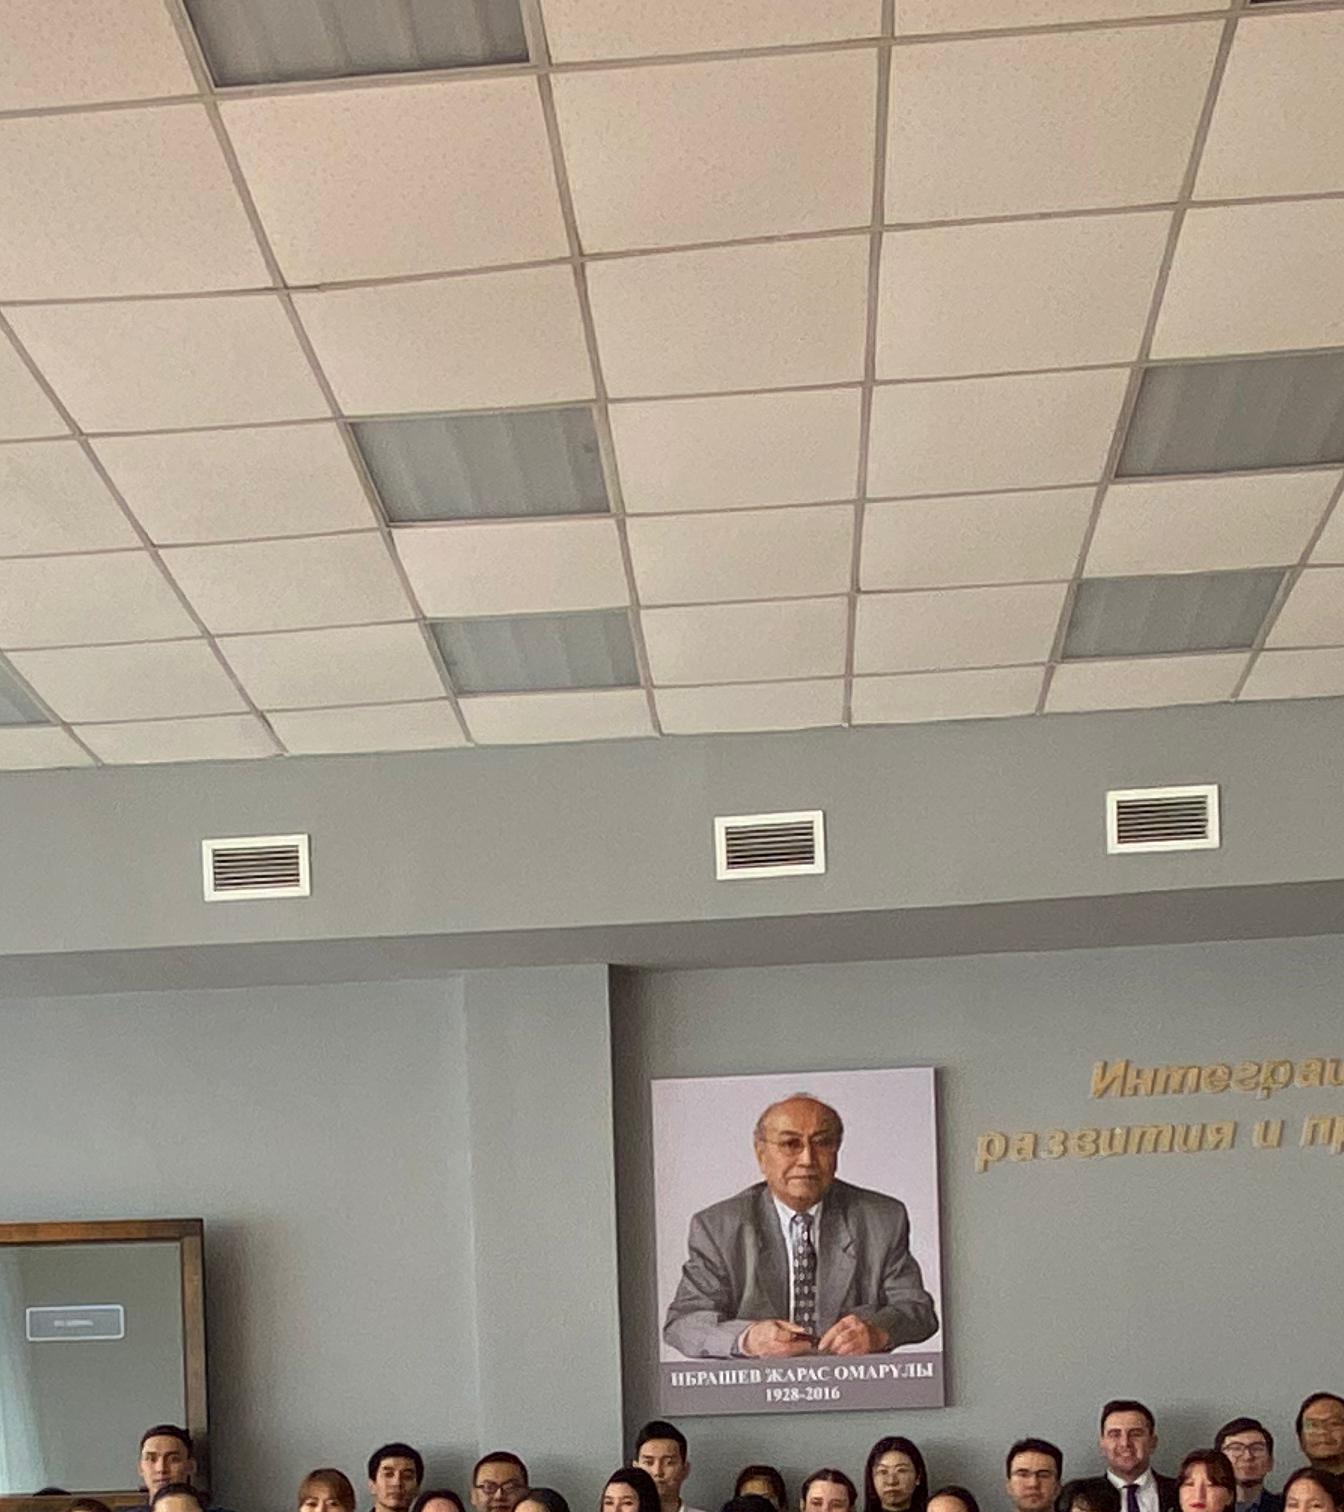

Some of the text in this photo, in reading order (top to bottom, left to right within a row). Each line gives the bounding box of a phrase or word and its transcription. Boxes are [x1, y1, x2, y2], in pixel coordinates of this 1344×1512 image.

[975, 1119, 1237, 1173] развития
[1253, 1119, 1285, 1148] и
[670, 1369, 762, 1387] ИБРАШЕВ
[766, 1366, 831, 1383] ЖАРАС
[765, 1386, 841, 1403] 1928-2016
